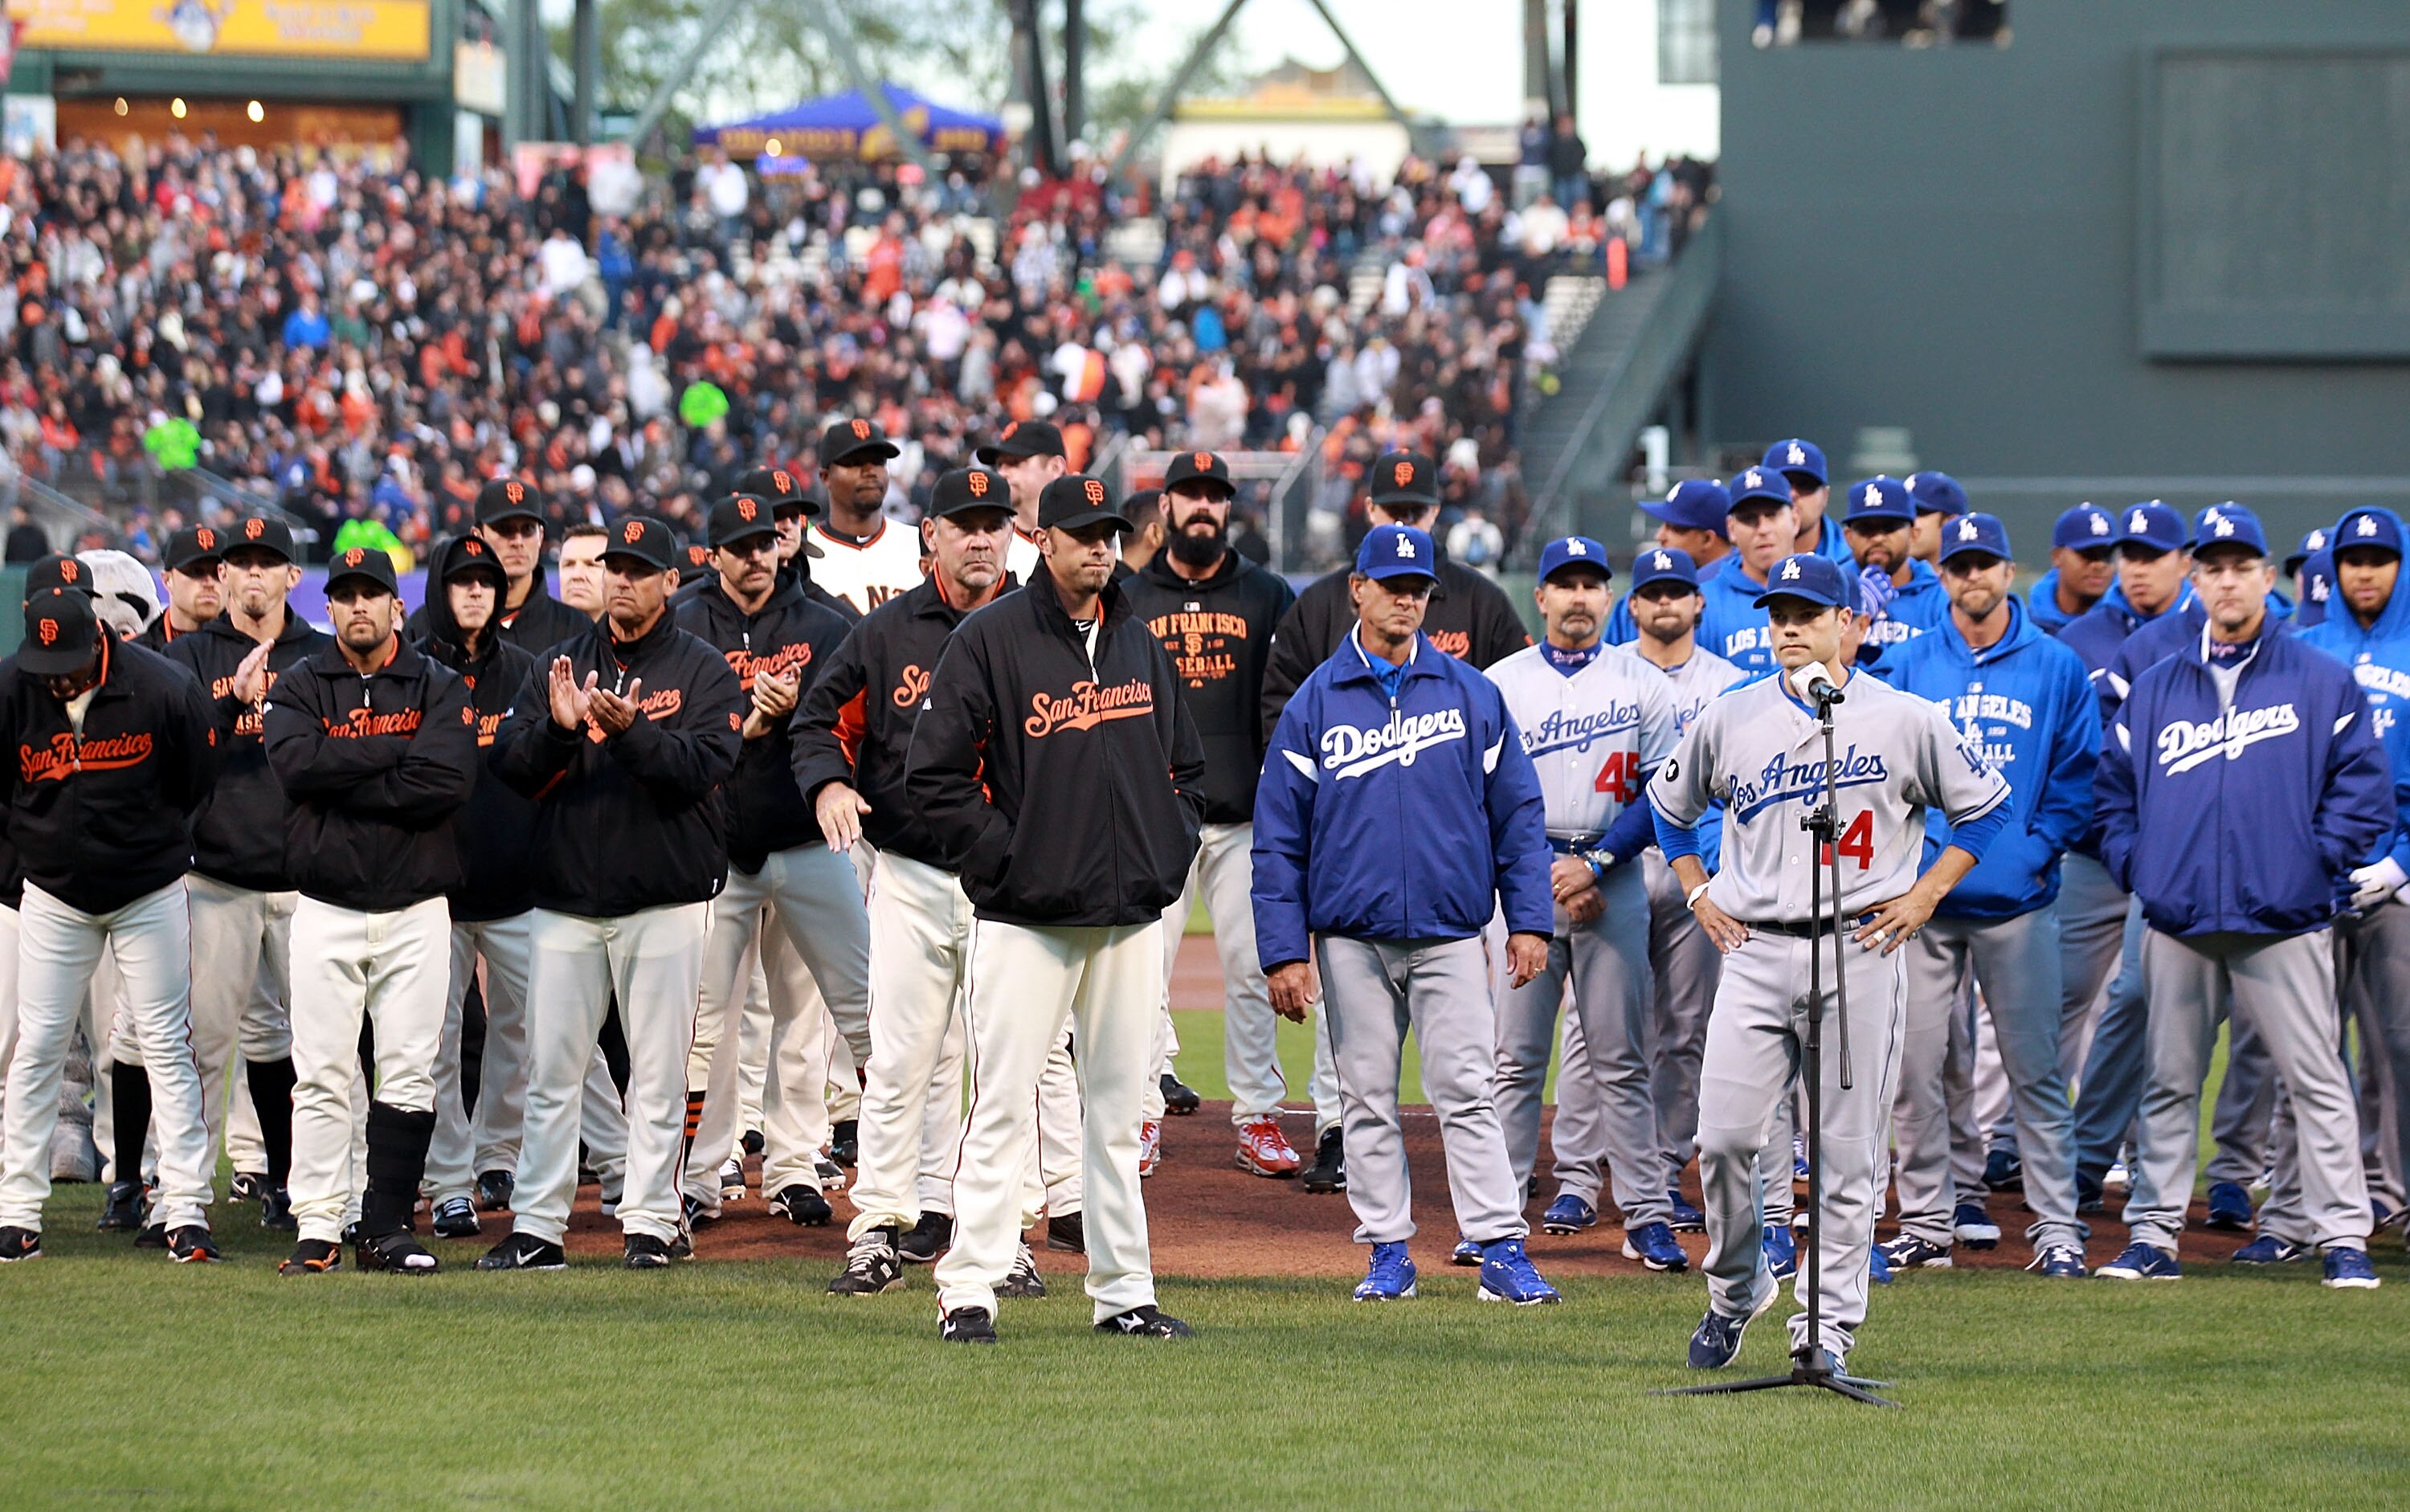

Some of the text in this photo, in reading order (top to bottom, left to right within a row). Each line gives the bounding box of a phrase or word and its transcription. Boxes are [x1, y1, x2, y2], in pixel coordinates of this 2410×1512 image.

[851, 419, 871, 440] SF
[506, 482, 524, 505] SF
[773, 471, 791, 494] SF
[969, 472, 989, 497] SF
[1084, 480, 1104, 505] SF
[737, 498, 757, 521] SF
[246, 518, 265, 540] SF
[624, 521, 644, 543] SF
[345, 548, 365, 567] SF
[1397, 533, 1415, 558] LA
[1566, 537, 1587, 556] LA
[1653, 550, 1673, 570] LA
[1781, 558, 1801, 581] LA
[40, 619, 59, 645] SF
[1147, 613, 1248, 640] AN FRANCISCO
[1185, 632, 1203, 657] SF
[1726, 627, 1757, 657] LOS
[725, 643, 812, 680] Francisco
[1175, 654, 1236, 671] SEBALL
[893, 664, 930, 707] Sa
[1024, 693, 1074, 738] San
[1955, 694, 2032, 729] ANGELES
[322, 717, 350, 738] an
[1538, 699, 1641, 753] Angeles
[2157, 703, 2300, 768] Dodgers
[1321, 709, 1466, 771] Dodgers
[20, 732, 153, 783] San Francisco
[1975, 744, 2016, 762] BALL
[1595, 752, 1640, 802] 45
[1729, 743, 1885, 814] Los Angeles
[1820, 810, 1874, 870] 4
